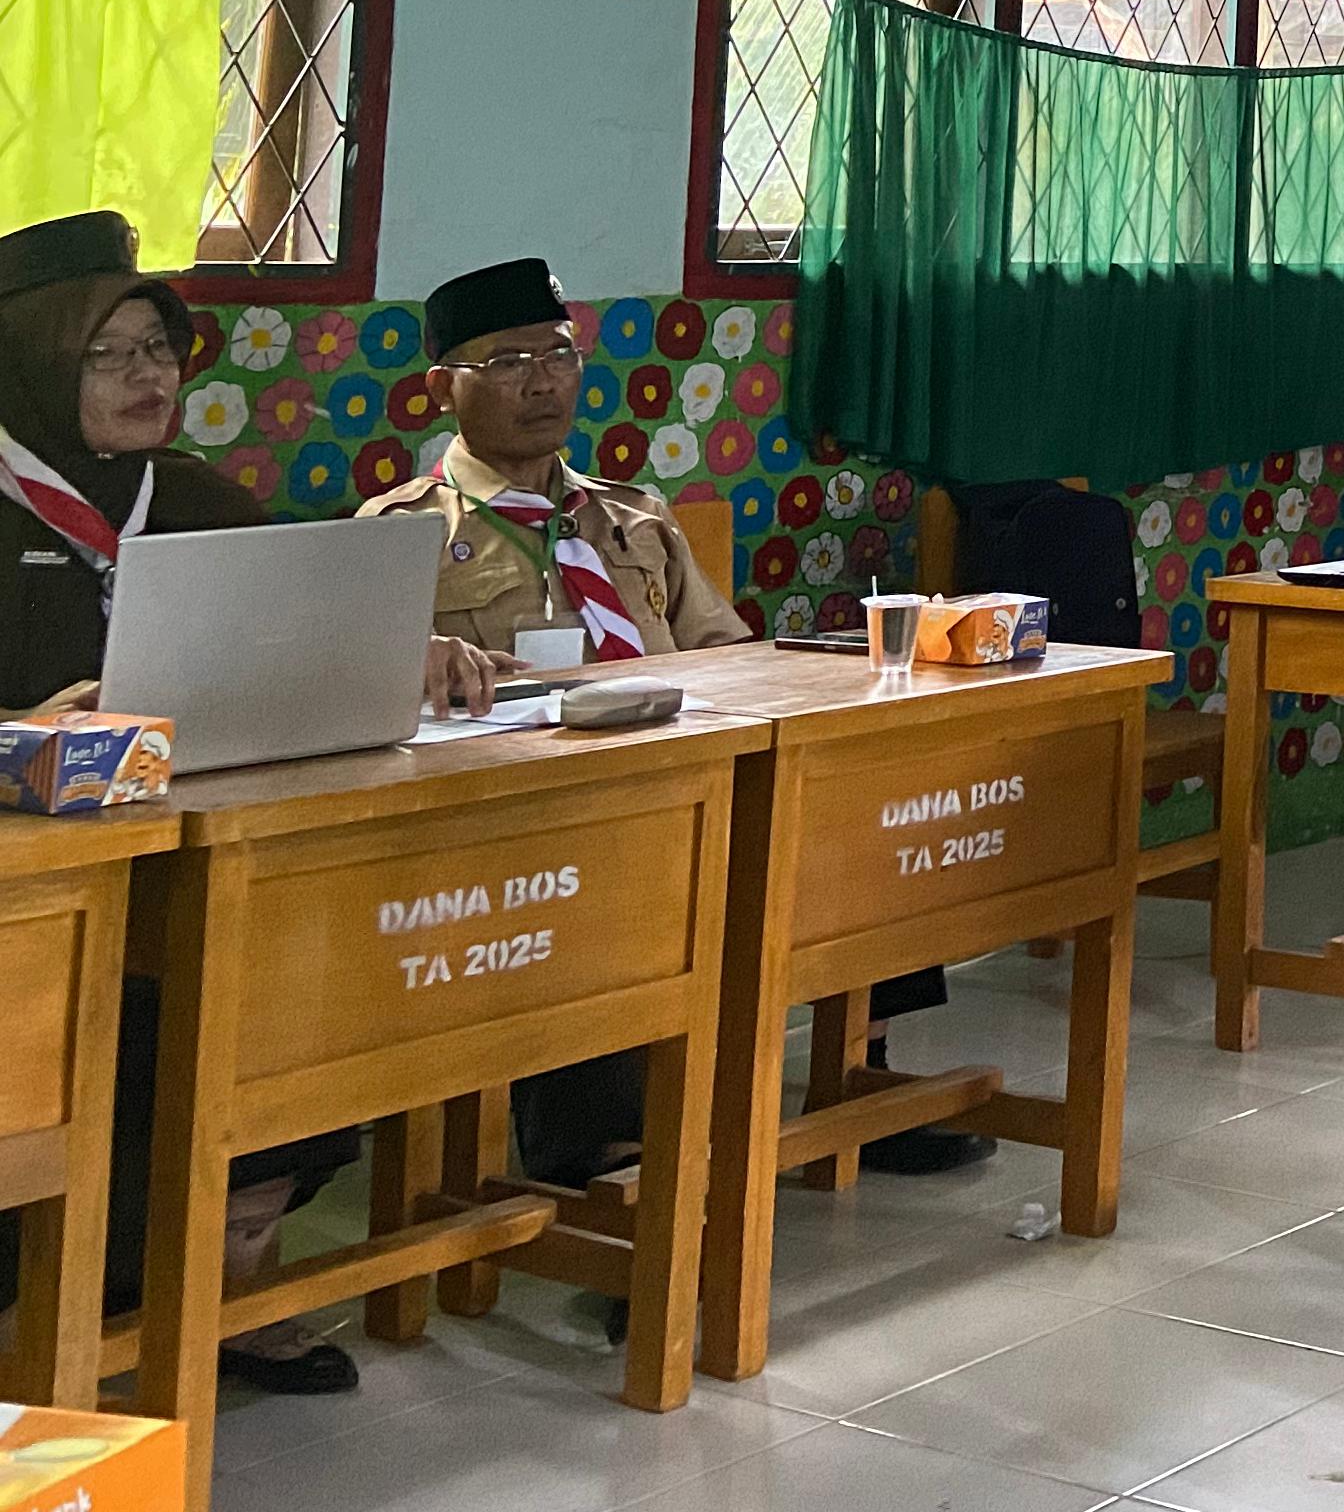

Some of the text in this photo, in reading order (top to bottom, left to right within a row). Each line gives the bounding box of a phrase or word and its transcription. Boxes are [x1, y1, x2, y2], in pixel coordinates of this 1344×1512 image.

[881, 776, 1024, 828] DANA BOS
[896, 828, 1005, 875] TA 2025
[379, 865, 580, 934] DANA BOS
[400, 929, 554, 988] TA 2025
